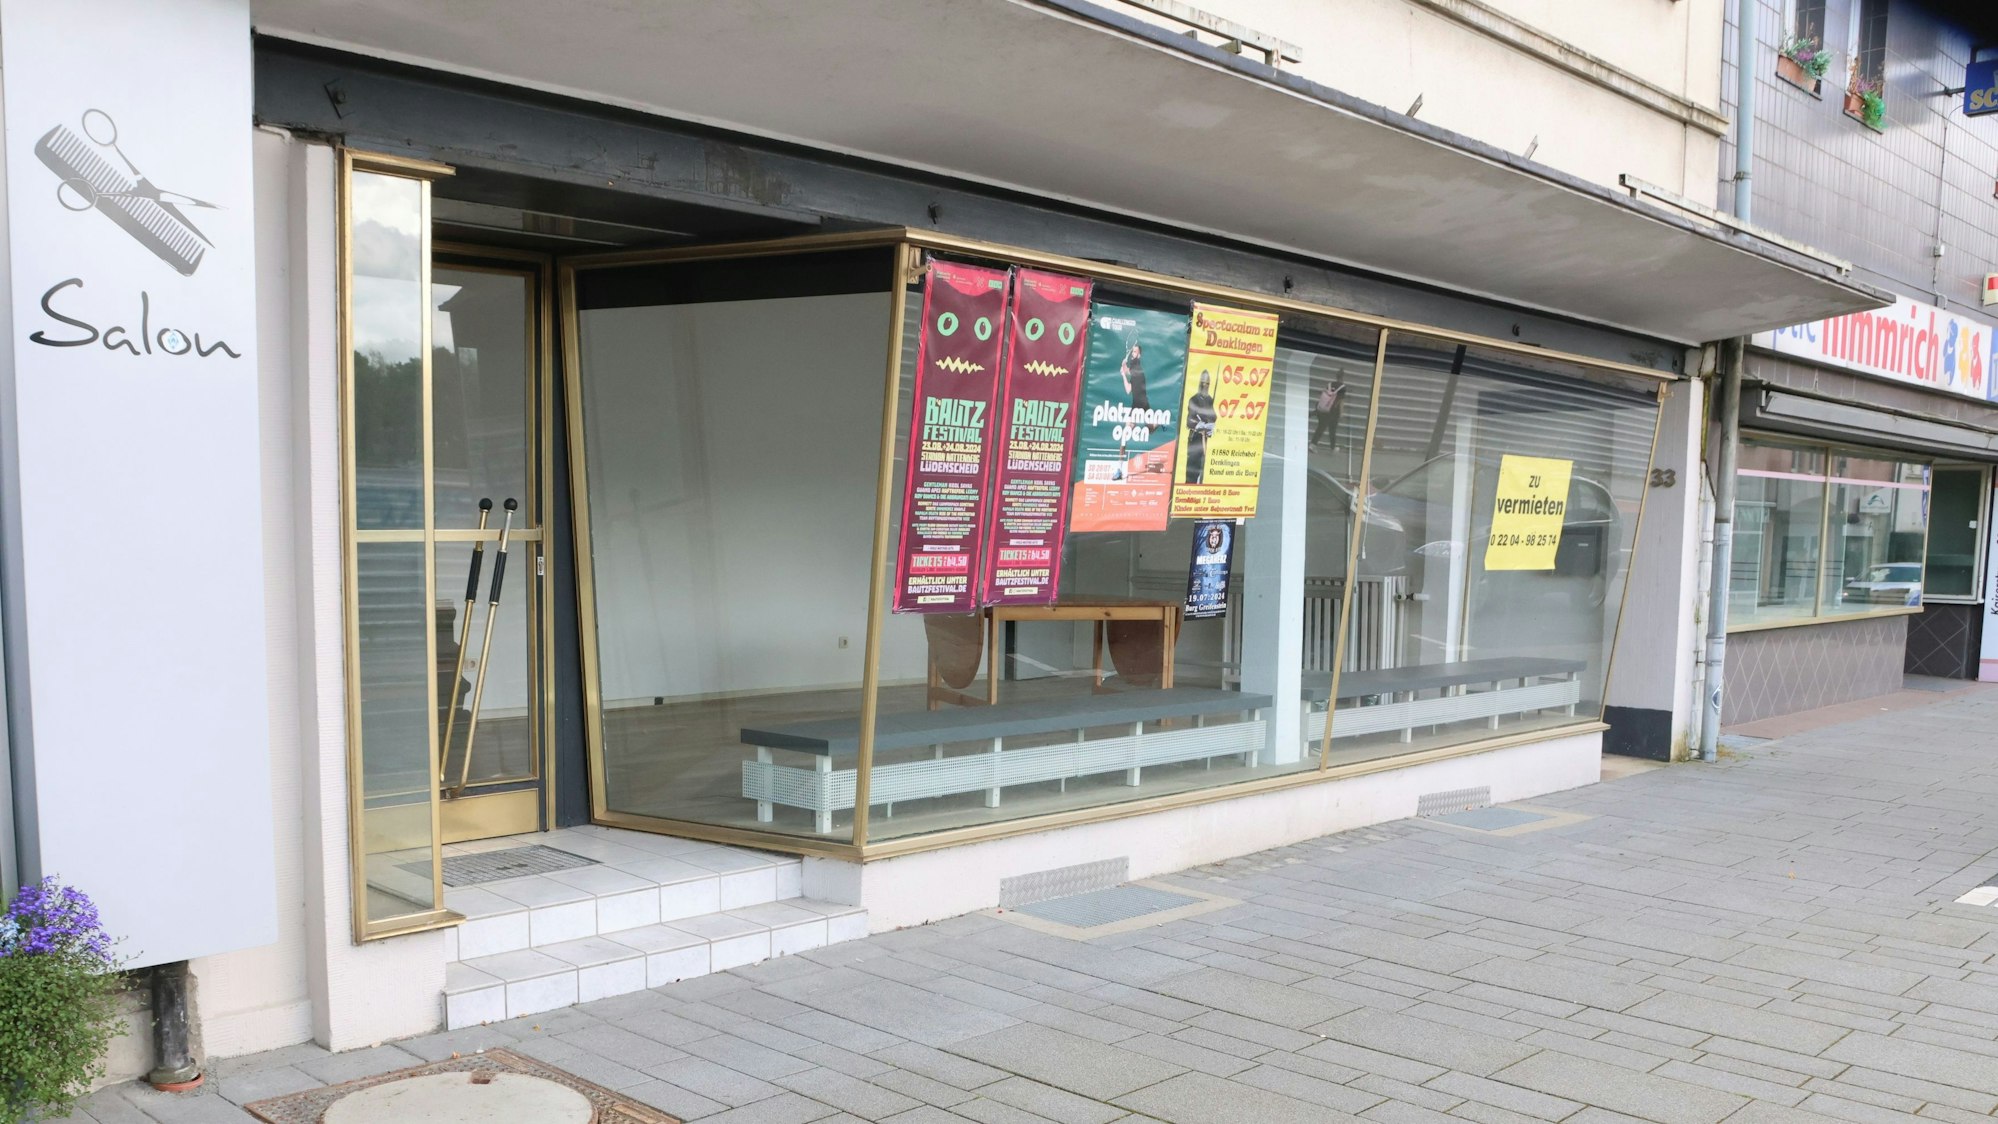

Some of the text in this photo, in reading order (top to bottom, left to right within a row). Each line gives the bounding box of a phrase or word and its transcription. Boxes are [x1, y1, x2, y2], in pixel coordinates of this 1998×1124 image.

[29, 277, 241, 359] Salon
[1206, 330, 1263, 354] Denklingen
[1223, 365, 1270, 387] 05.07
[925, 396, 986, 428] BAUTZ
[1012, 398, 1069, 428] BAUTZ
[1093, 400, 1171, 426] platzmann
[1219, 399, 1266, 420] 07.07
[923, 424, 982, 443] FESTIVAL
[1010, 424, 1064, 443] FESTIVAL
[1112, 425, 1149, 446] open
[920, 461, 979, 474] LÜDENSCHEID
[1007, 459, 1061, 472] LÜDENSCHEID
[1210, 459, 1240, 467] Denklingen
[1244, 470, 1258, 478] Burg
[1650, 468, 1676, 488] 33
[1497, 495, 1564, 516] vermieten
[1490, 535, 1495, 546] 0
[1497, 534, 1508, 546] 22
[1510, 535, 1520, 546] 04
[1526, 535, 1536, 546] 98
[1537, 535, 1547, 546] 25
[1548, 535, 1557, 546] 74
[912, 555, 942, 567] TICKETS
[1000, 549, 1027, 560] TICKETS
[1196, 554, 1227, 565] MEGAHERZ
[996, 568, 1049, 577] ERHÄLTLICH UNTER
[908, 575, 967, 585] ERHÄLTLICH UNTER
[995, 577, 1049, 586] BAUTZFESTIVAL.DE
[908, 585, 967, 594] BAUTZFESTIVAL.DE
[1189, 592, 1225, 602] 19.07.2024
[1185, 602, 1227, 612] Burg Greifenstein
